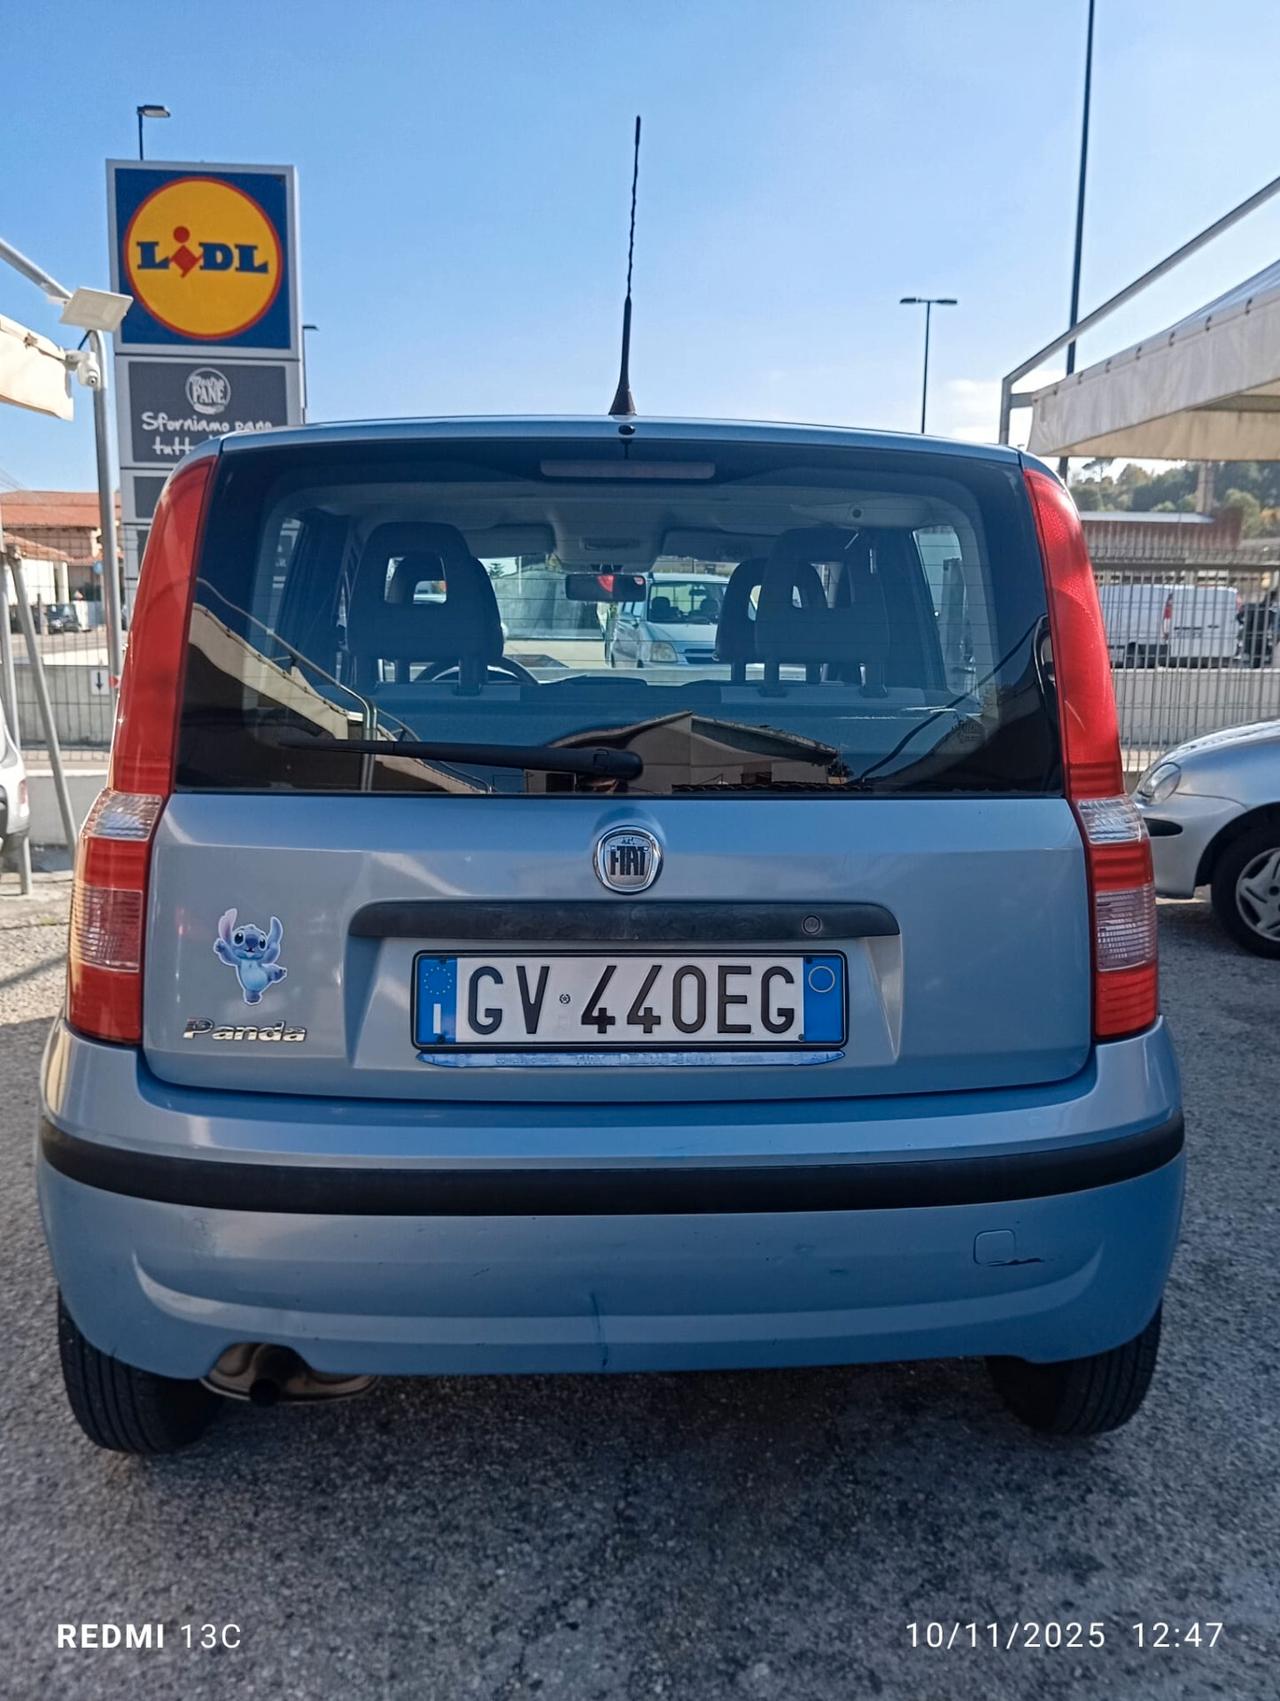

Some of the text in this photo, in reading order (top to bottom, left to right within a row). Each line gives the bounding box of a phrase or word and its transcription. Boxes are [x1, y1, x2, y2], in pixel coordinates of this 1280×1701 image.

[192, 385, 225, 403] PANE
[141, 411, 230, 432] Sforniamo
[152, 436, 196, 455] tutt
[608, 845, 650, 876] FIAT
[183, 1017, 306, 1041] Panda
